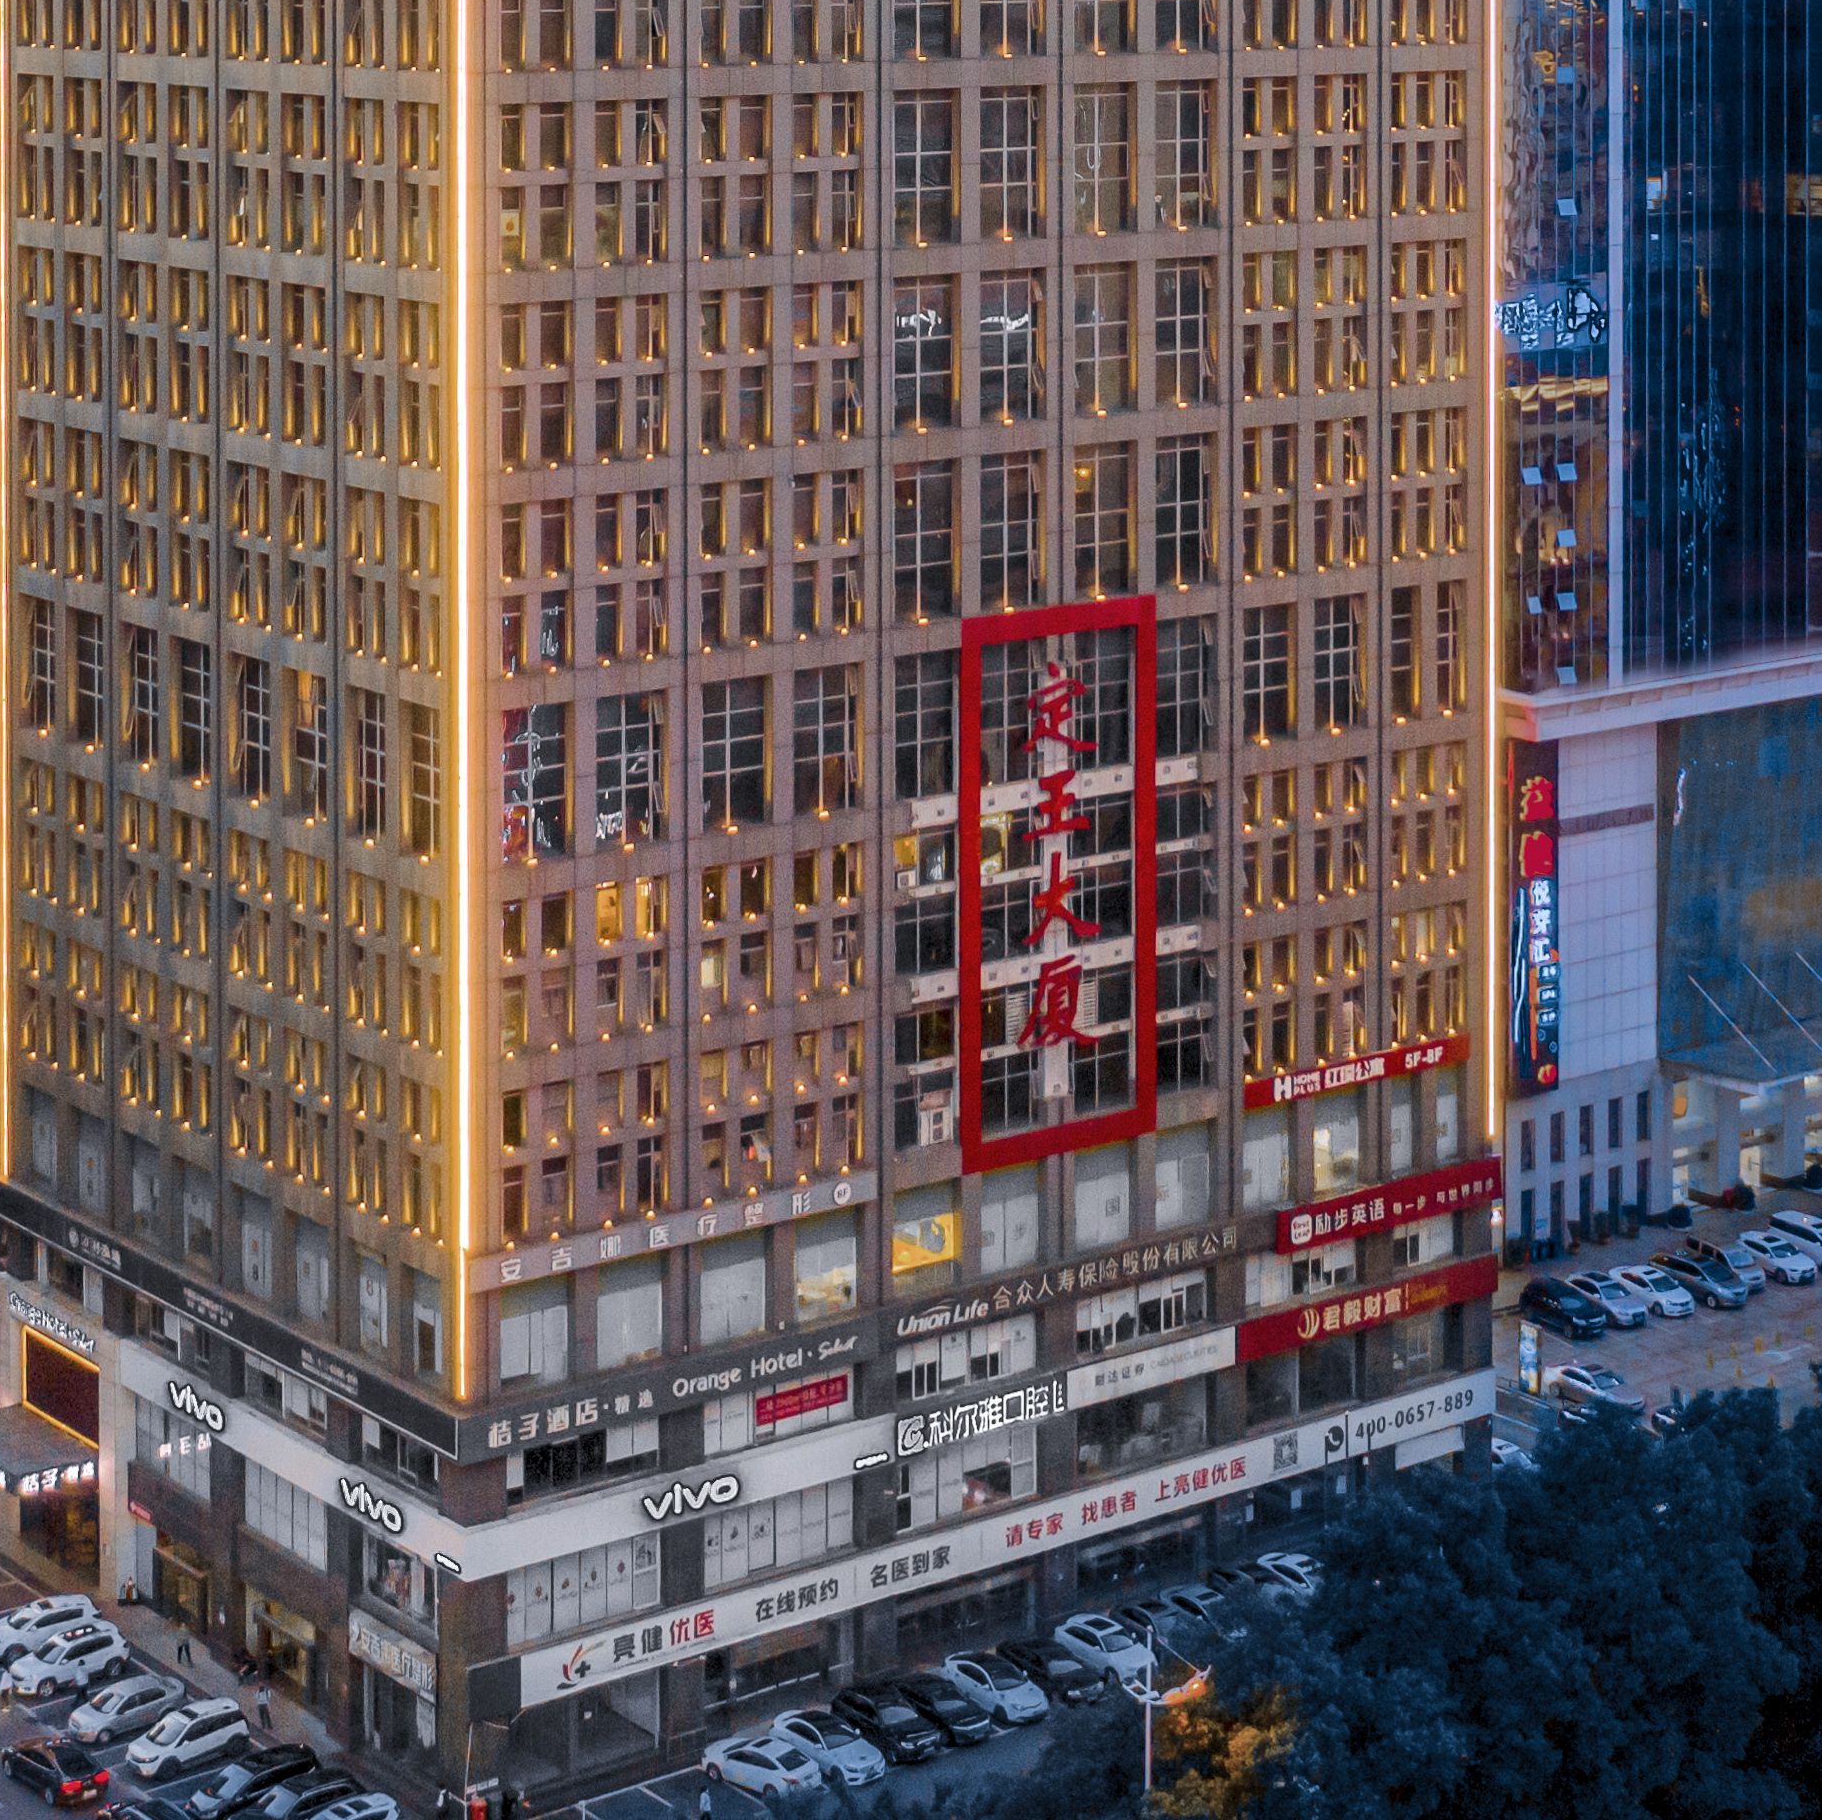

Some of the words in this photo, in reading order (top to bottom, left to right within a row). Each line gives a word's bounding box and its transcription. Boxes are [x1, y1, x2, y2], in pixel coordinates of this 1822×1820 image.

[1017, 661, 1101, 1047] 定王大厦
[1293, 1071, 1320, 1086] HOME
[1293, 1082, 1321, 1096] PLUS
[500, 1191, 812, 1284] 安吉娜医疗整形
[1315, 1197, 1385, 1236] 励步英语
[993, 1225, 1238, 1312] 合众人寿保险股份有限公司
[897, 1307, 952, 1337] Union
[952, 1299, 989, 1325] Life
[672, 1367, 742, 1398] Orange
[751, 1347, 803, 1379] Hotel
[168, 1381, 224, 1431] vivo
[929, 1384, 1050, 1447] 科尔雅口腔
[339, 1478, 402, 1532] vivo
[643, 1474, 740, 1521] vivo
[755, 1577, 839, 1623] 在线预约
[869, 1544, 952, 1588] 名医到家
[1004, 1511, 1065, 1548] 请专家
[1080, 1488, 1138, 1527] 找患者
[1153, 1455, 1248, 1506] 上亮健优医
[1355, 1389, 1475, 1440] 400-0657-889
